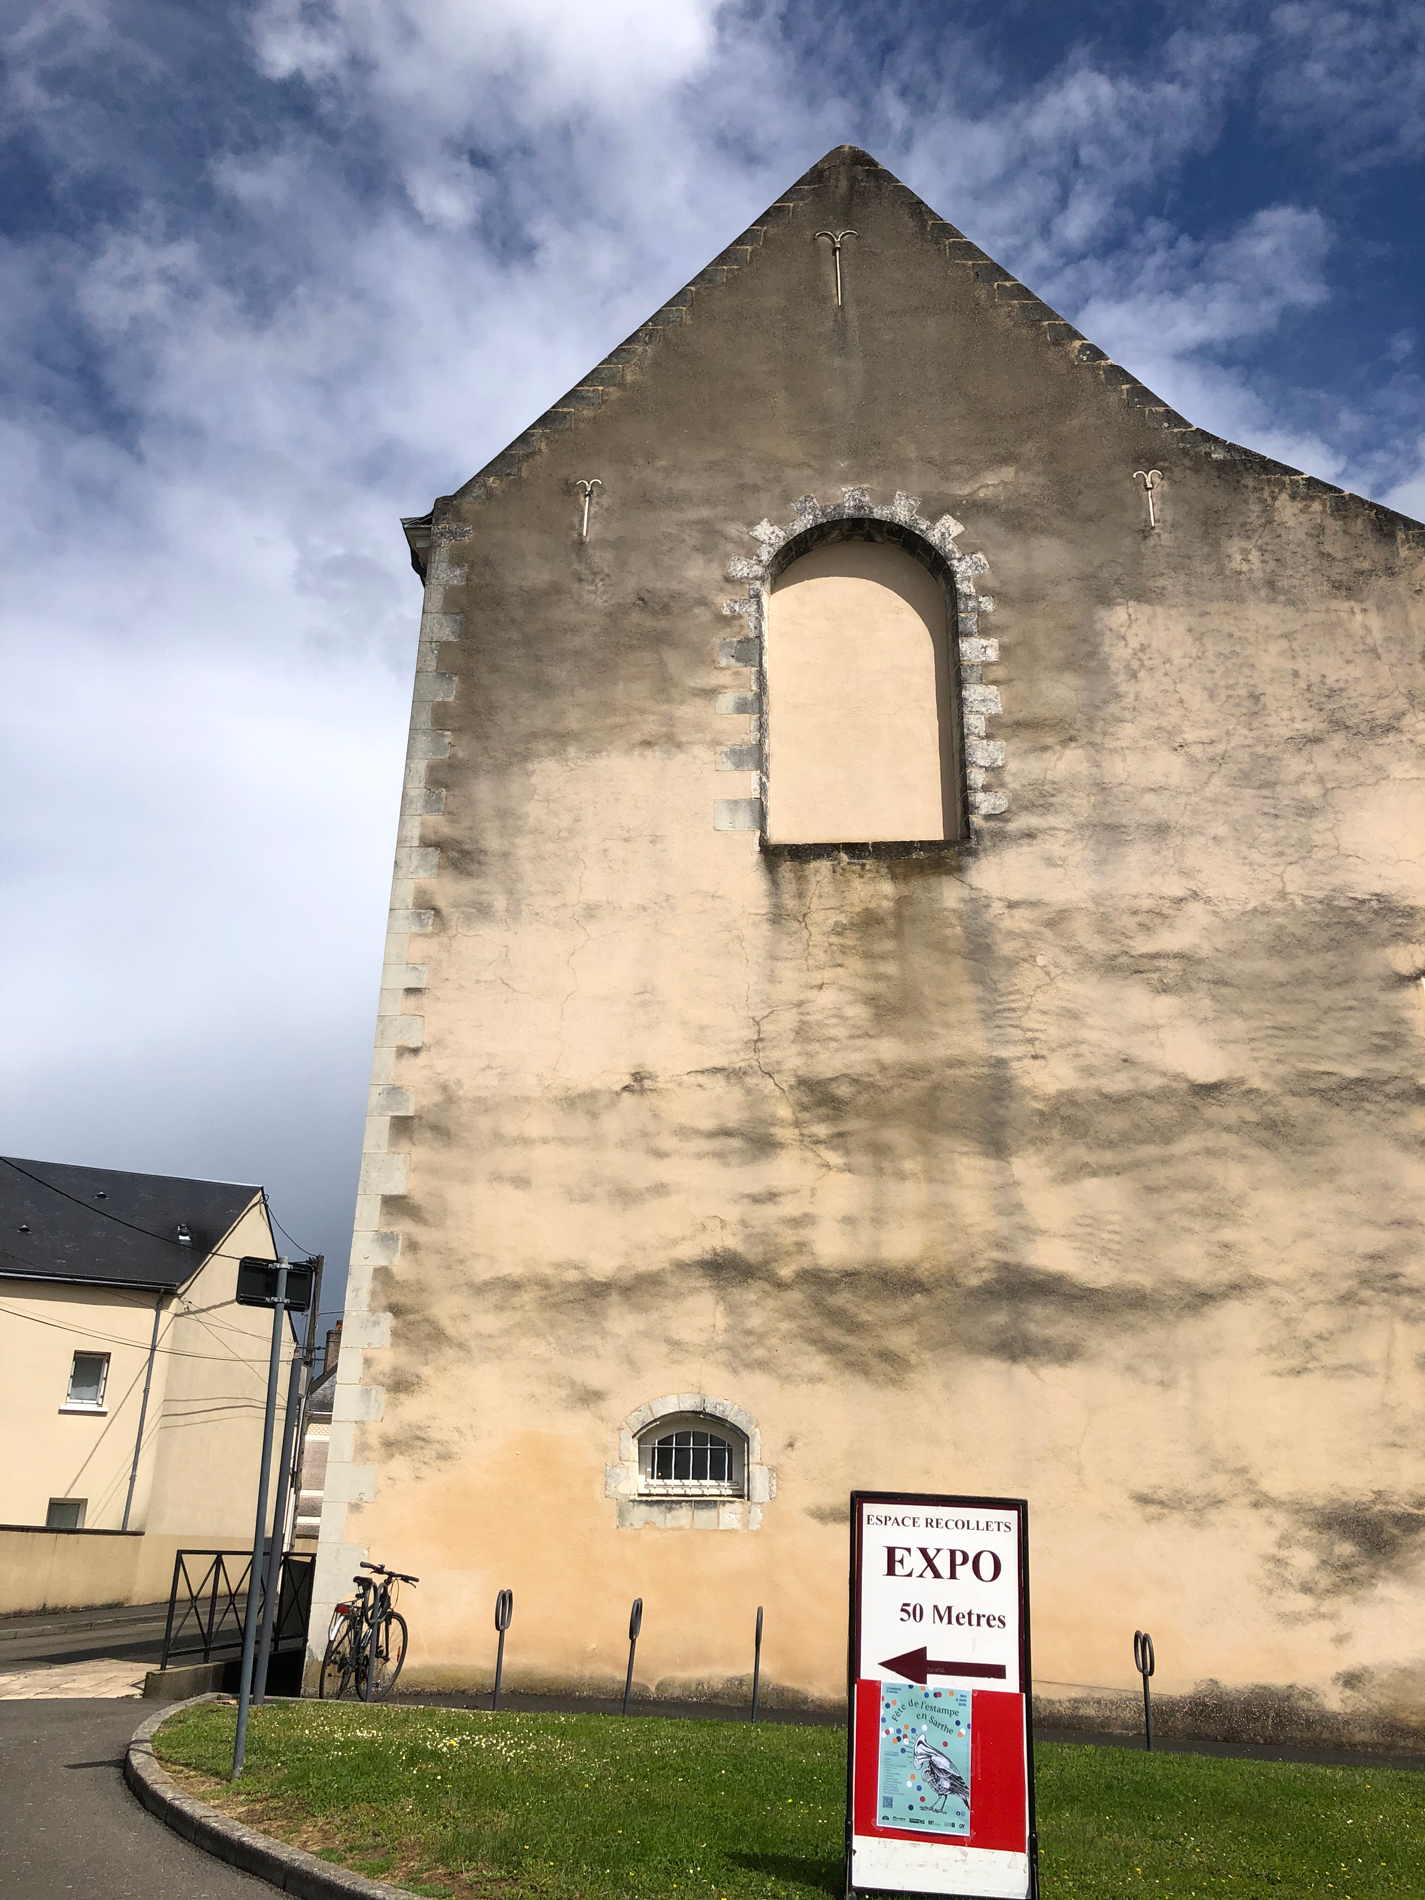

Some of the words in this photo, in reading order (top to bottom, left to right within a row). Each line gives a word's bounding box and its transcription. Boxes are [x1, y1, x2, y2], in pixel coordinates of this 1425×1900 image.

[866, 1514, 921, 1528] ESPACE
[925, 1517, 1012, 1533] RECOLLETS
[882, 1545, 1002, 1583] EXPO
[899, 1602, 924, 1623] 50
[932, 1604, 1007, 1629] Metres
[908, 1698, 919, 1708] de
[920, 1701, 960, 1718] l'estampe
[928, 1716, 954, 1735] Sarthe
